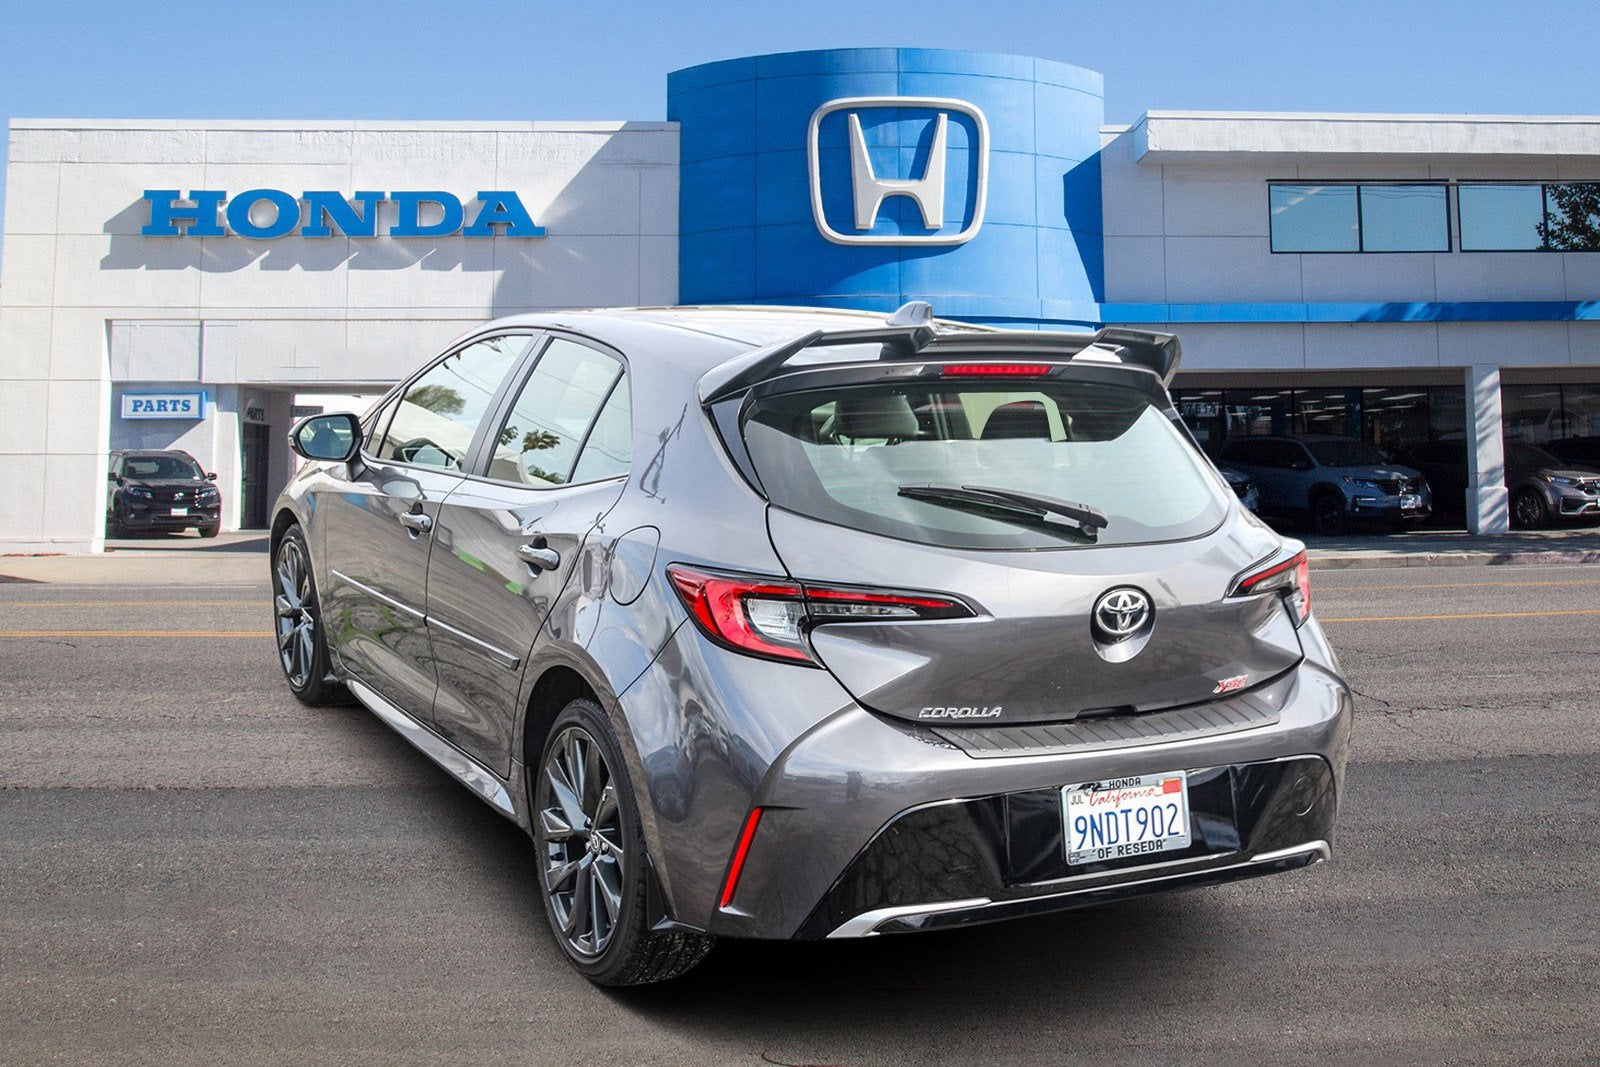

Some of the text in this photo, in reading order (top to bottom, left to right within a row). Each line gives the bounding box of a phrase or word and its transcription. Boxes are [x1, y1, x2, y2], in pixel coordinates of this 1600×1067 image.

[141, 188, 547, 239] HONDA
[132, 399, 191, 413] PARTS
[918, 706, 1003, 719] COROLLA
[1108, 777, 1142, 790] HONDA
[1070, 794, 1084, 806] JUL
[1089, 786, 1163, 809] California
[1074, 802, 1180, 850] 9NDT902
[1098, 839, 1163, 859] OF RESEDA
